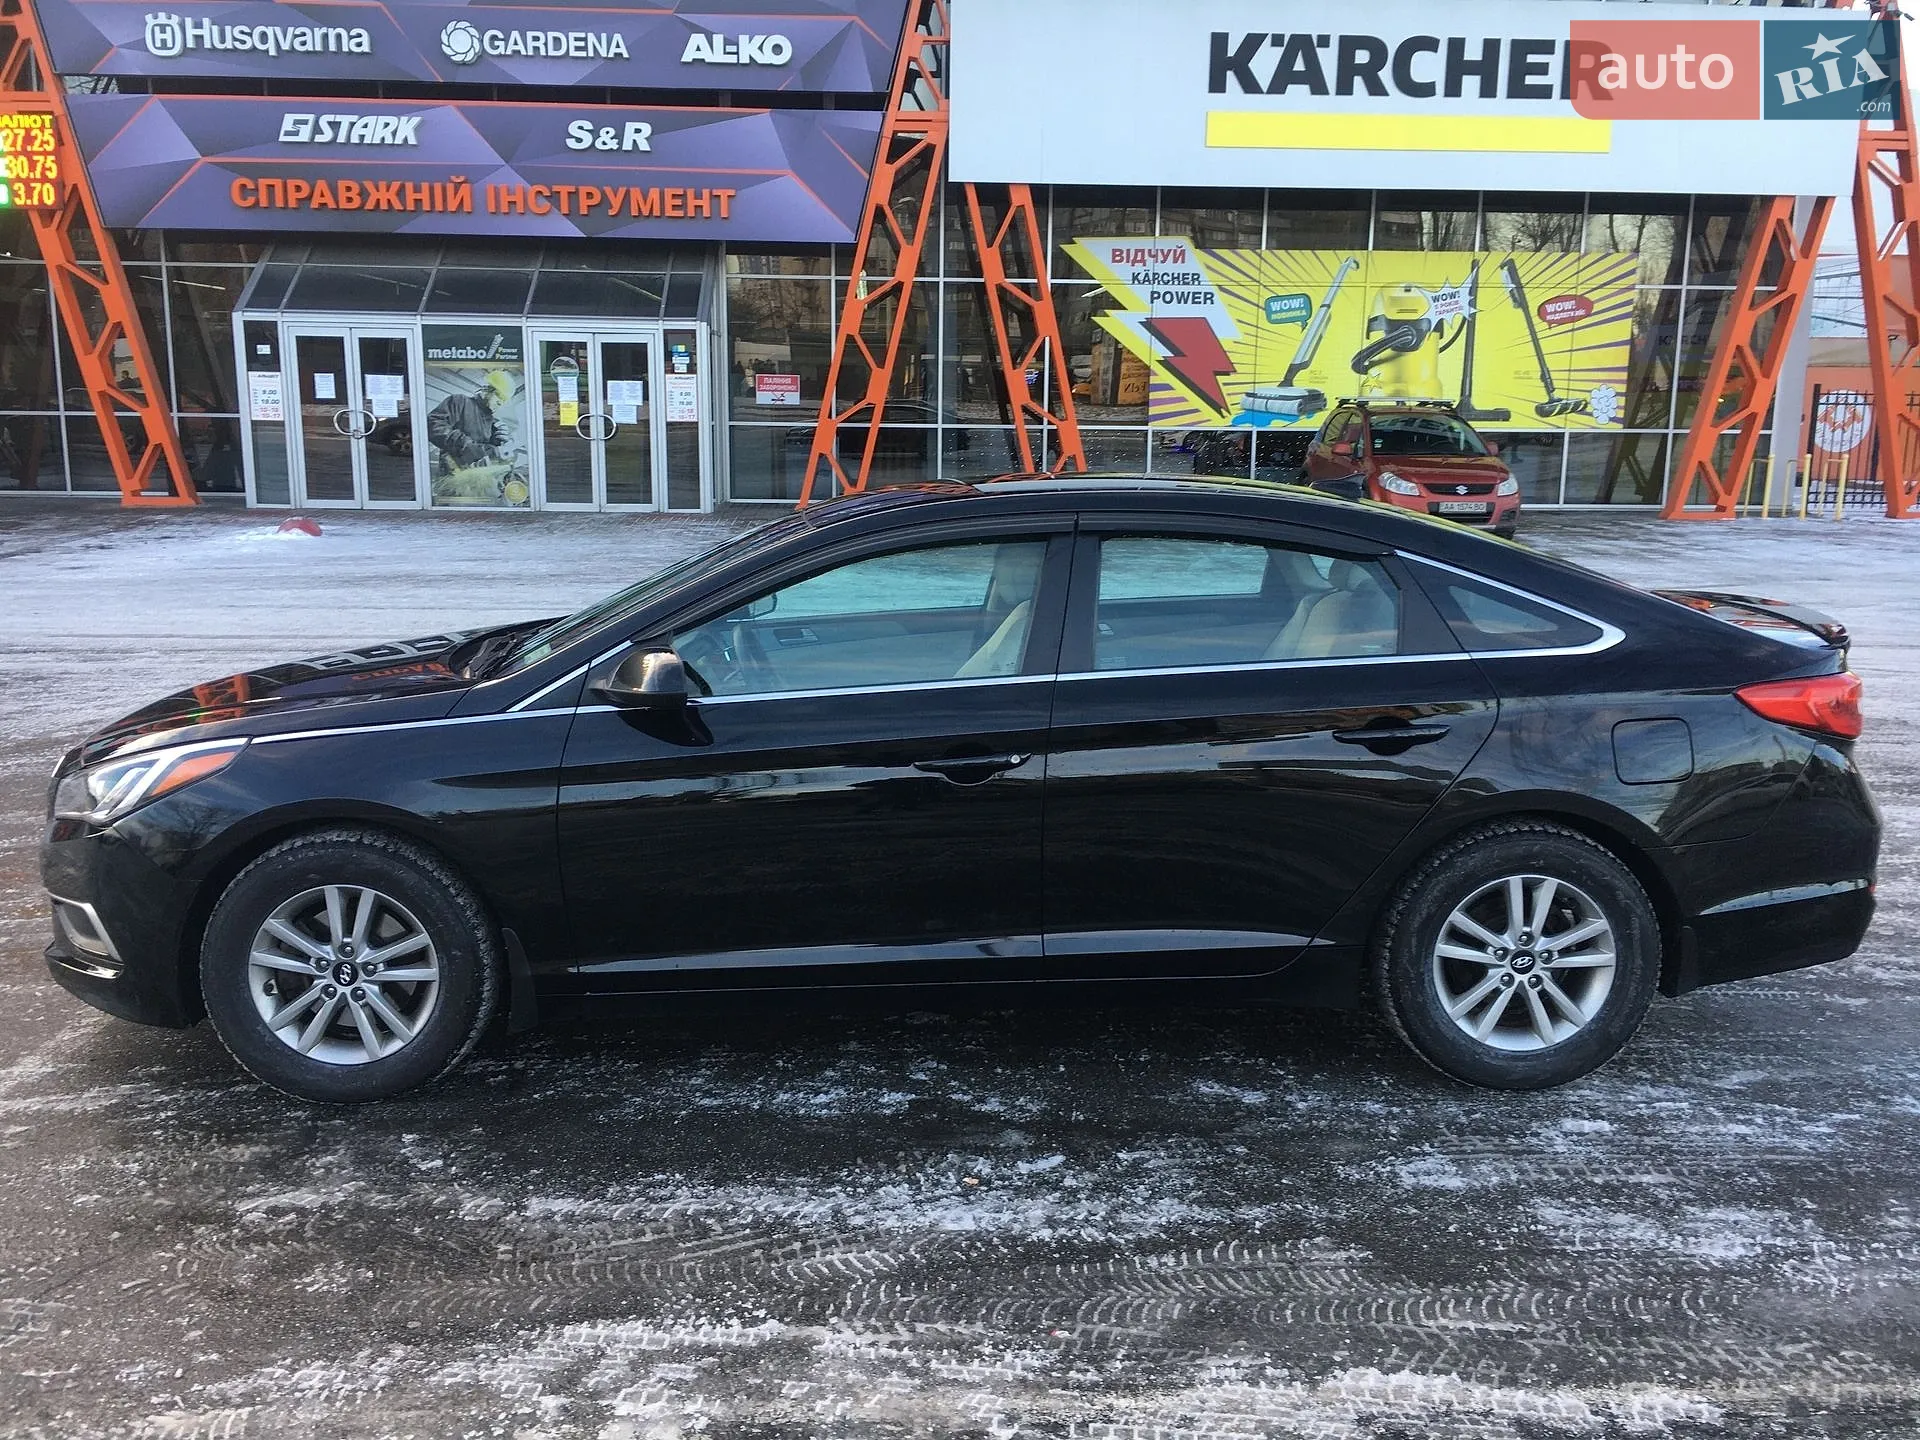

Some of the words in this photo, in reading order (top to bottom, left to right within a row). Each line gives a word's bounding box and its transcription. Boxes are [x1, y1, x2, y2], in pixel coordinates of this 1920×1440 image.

[184, 16, 373, 57] Husqvarna
[483, 29, 630, 59] GARDENA
[1208, 32, 1615, 101] KÄRCHER
[0, 114, 53, 129] АЛЮТ
[314, 114, 424, 145] STARK
[565, 120, 652, 152] S&R
[13, 182, 56, 206] 3.70
[230, 175, 474, 213] СПРАВЖНІЙ
[487, 183, 736, 219] ІНСТРУМЕНТ
[1111, 245, 1186, 267] ВІДЧУЙ
[1131, 269, 1201, 286] KÄRCHER
[1150, 290, 1215, 305] POWER
[1269, 297, 1305, 312] WOW!
[1431, 290, 1461, 304] WOW!
[1544, 299, 1576, 313] WOW!
[427, 346, 487, 359] metabo
